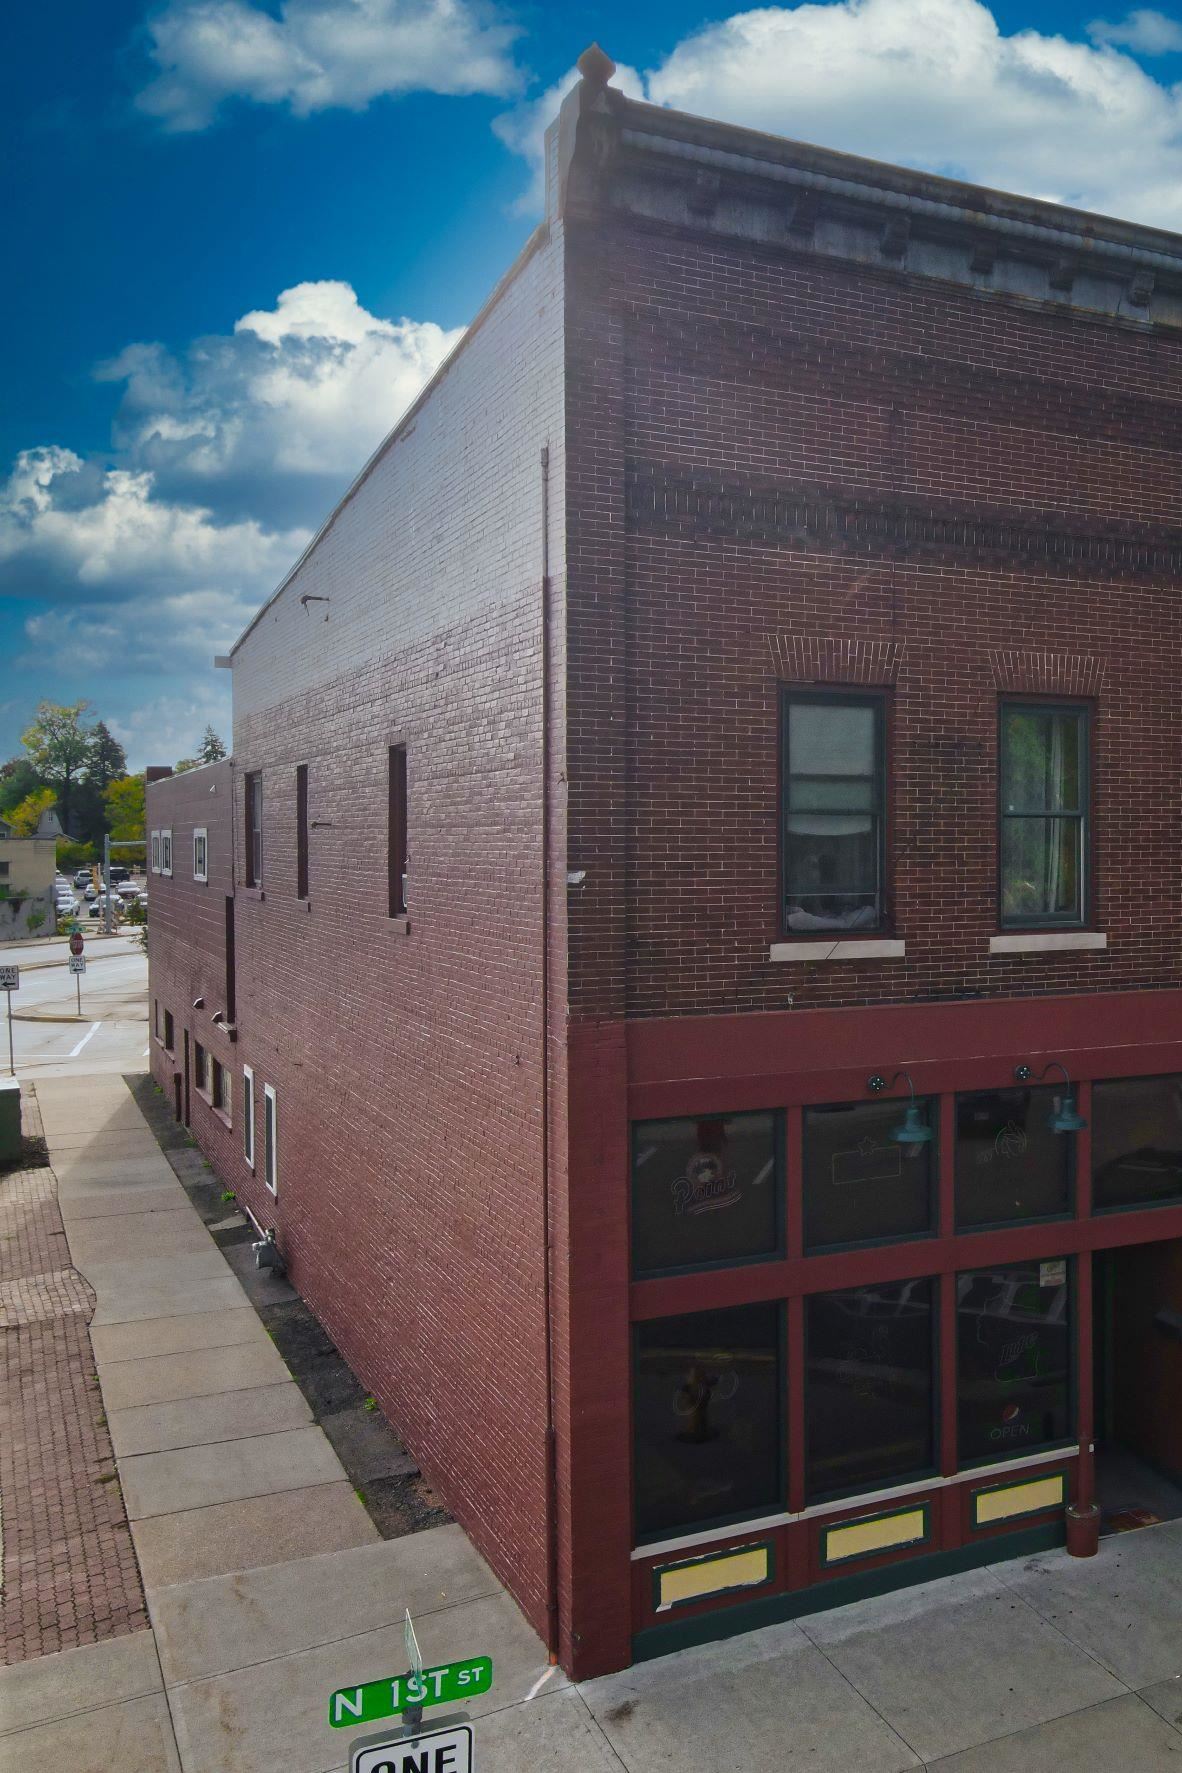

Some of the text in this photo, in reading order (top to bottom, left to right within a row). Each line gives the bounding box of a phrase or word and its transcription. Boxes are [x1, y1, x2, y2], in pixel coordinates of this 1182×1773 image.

[990, 1423, 1031, 1440] OPEN
[334, 1666, 484, 1721] N 1ST ST
